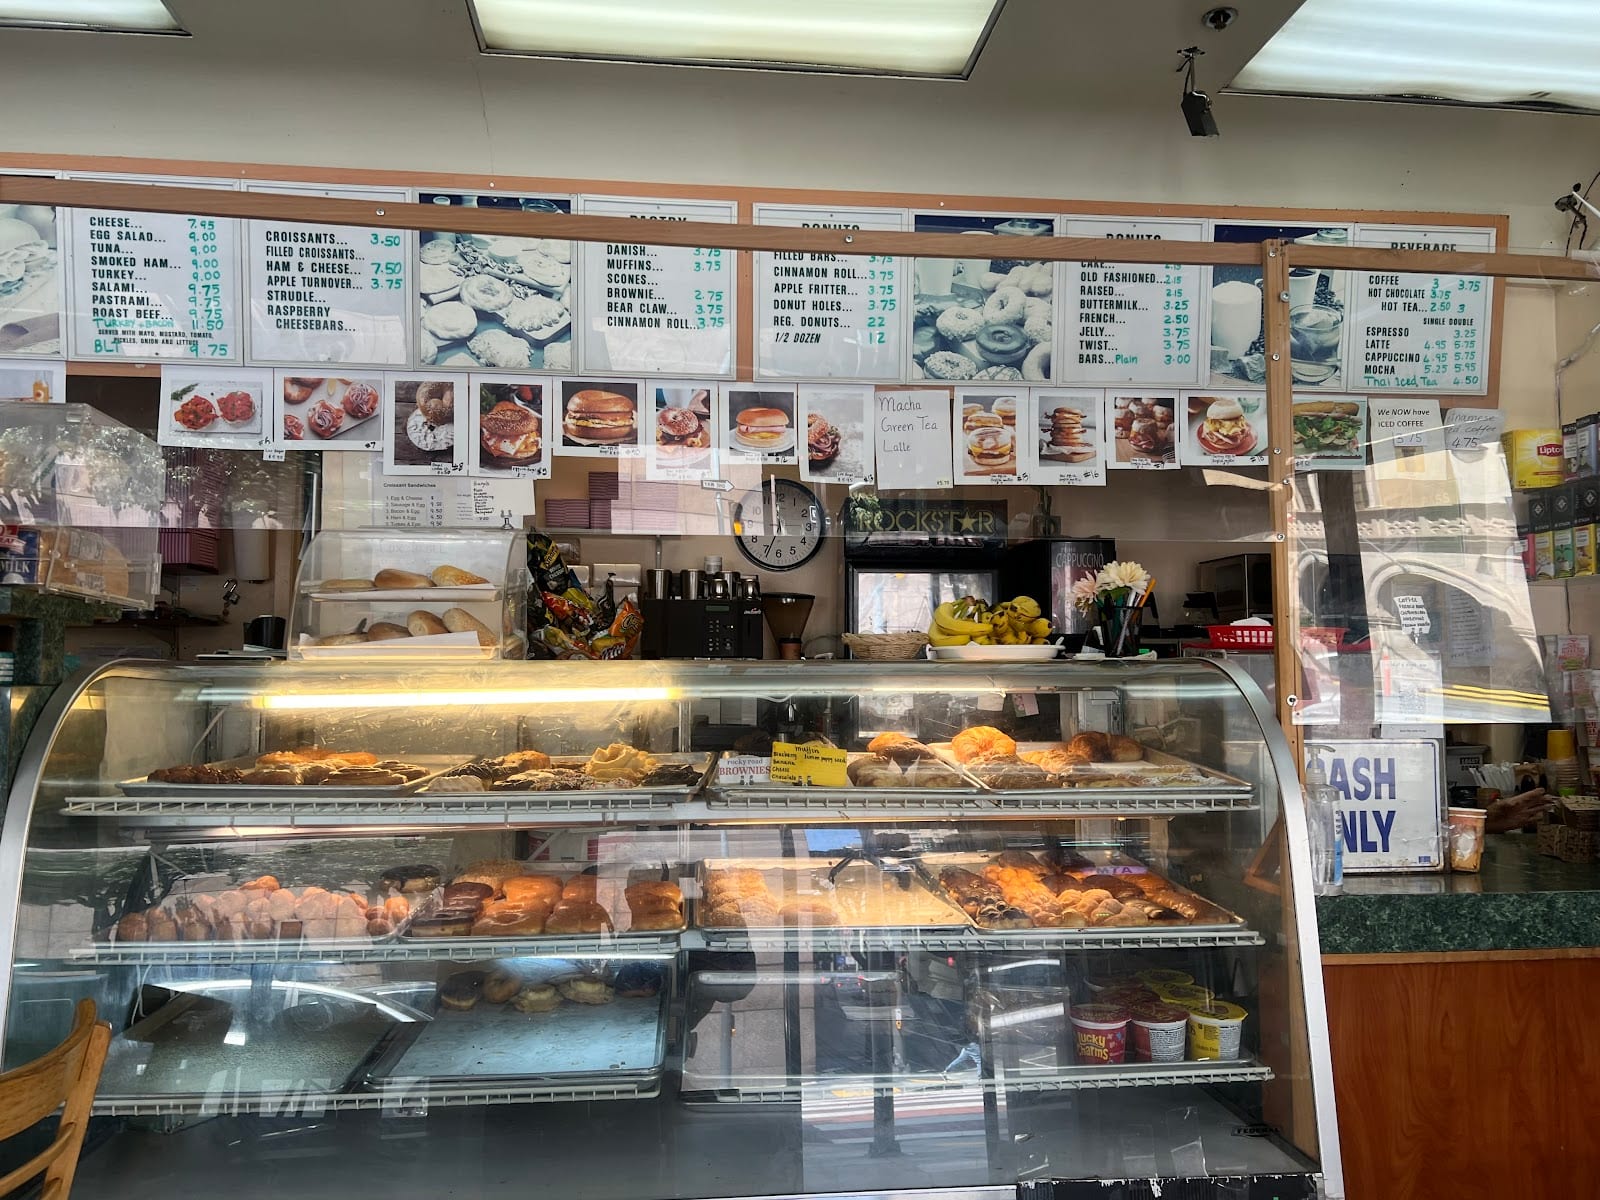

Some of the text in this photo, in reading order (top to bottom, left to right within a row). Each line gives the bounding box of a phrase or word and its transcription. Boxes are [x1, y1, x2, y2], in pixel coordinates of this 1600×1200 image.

[188, 219, 215, 230] 7.95
[90, 230, 110, 240] EGG
[188, 232, 216, 242] 9.00
[370, 233, 400, 246] 3.50
[190, 245, 217, 256] 9.00
[266, 245, 293, 257] FILLED
[774, 252, 804, 261] FILLED
[91, 256, 136, 266] SMOKED
[192, 259, 218, 270] 9.00
[266, 260, 290, 272] HAM
[298, 262, 304, 272] &
[370, 262, 402, 275] 7.50
[694, 260, 721, 272] 3.75
[192, 271, 220, 282] 9.00
[774, 266, 828, 278] CINNAMON
[1080, 272, 1098, 282] OLD
[267, 276, 296, 286] APPLE
[371, 278, 402, 290] 3.75
[774, 283, 803, 294] APPLE
[1369, 276, 1480, 292] COFFEE 3 3.75
[188, 284, 220, 296] 9.75
[694, 290, 723, 301] 2.75
[1368, 288, 1382, 298] HOT
[1386, 289, 1425, 298] CHOCOLATE
[188, 296, 220, 308] 9.75
[774, 300, 806, 310] DONUT
[868, 299, 896, 311] 3.75
[1164, 300, 1189, 310] 3.25
[1382, 302, 1398, 311] HOT
[1430, 302, 1451, 312] 2.50
[268, 305, 330, 317] RASPBERRY
[608, 302, 632, 312] BEAR
[696, 304, 723, 314] 3.75
[92, 308, 128, 318] ROAST
[188, 309, 222, 320] 9.75
[1164, 314, 1188, 324] 2.50
[192, 320, 224, 330] 11.50
[608, 316, 660, 328] CINNAMON
[697, 317, 725, 329] 3.75
[774, 316, 794, 326] REG.
[868, 316, 886, 328] 22
[1449, 318, 1474, 326] DOUBLE
[775, 332, 789, 343] 1/2
[794, 333, 821, 344] DOZEN
[1164, 328, 1190, 339] 3.75
[1366, 327, 1476, 338] ESPRESSO 3.25
[94, 339, 228, 357] BLT 9.75
[1164, 340, 1190, 351] 3.75
[1366, 340, 1390, 349] LATTE
[1424, 341, 1446, 350] 4.95
[1115, 354, 1138, 364] Plain
[1164, 354, 1190, 365] 3.00
[1366, 352, 1420, 362] CAPPUCCINO
[1454, 352, 1476, 360] 5.75
[1365, 365, 1395, 374] MOCHA
[1424, 364, 1448, 374] 5.25
[1364, 376, 1390, 386] Thai
[879, 396, 922, 412] Macha
[881, 416, 938, 432] Green Tea
[1378, 420, 1394, 428] ICED
[801, 509, 808, 518] 2
[806, 523, 812, 532] 3
[800, 537, 806, 545] 4
[763, 545, 769, 554] 7
[776, 550, 782, 558] 6
[790, 546, 796, 555] 5
[720, 766, 770, 776] BROWNIES
